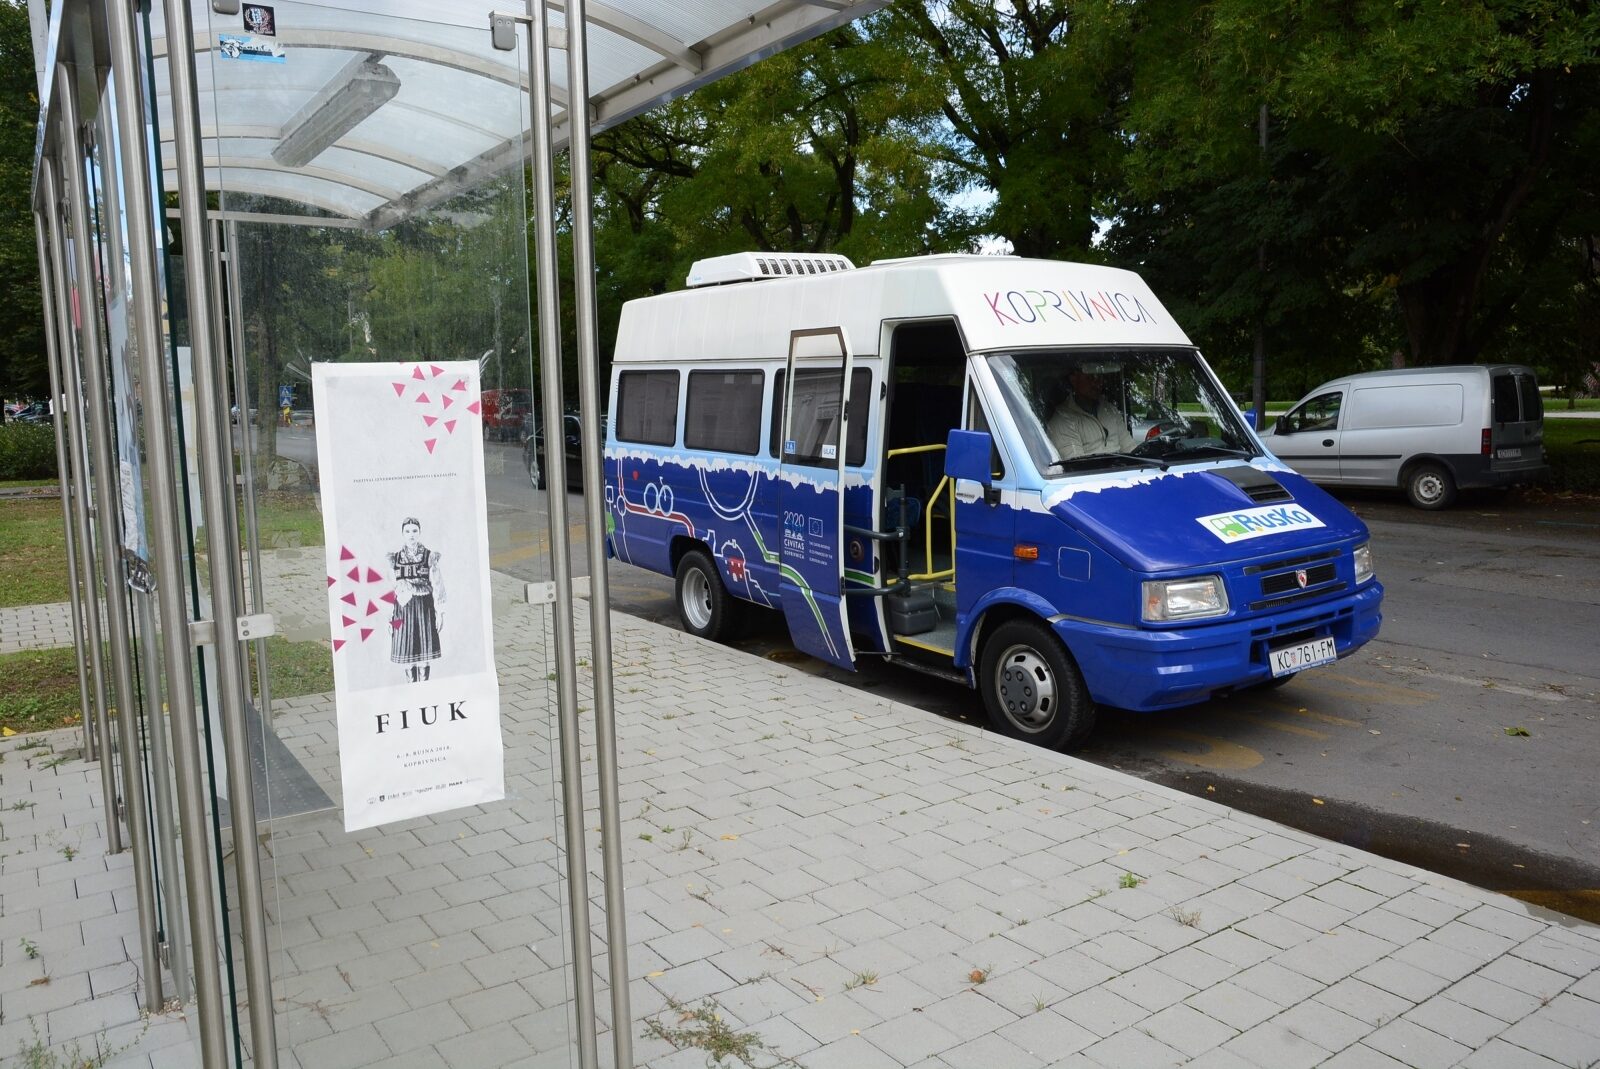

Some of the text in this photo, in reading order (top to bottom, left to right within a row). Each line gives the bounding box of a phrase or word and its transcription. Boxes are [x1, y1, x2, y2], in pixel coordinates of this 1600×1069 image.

[983, 290, 1157, 326] KOPRIVNICA
[784, 539, 805, 550] CIVITAS
[376, 702, 468, 734] FIUK
[403, 756, 447, 768] KOPRIVNICA
